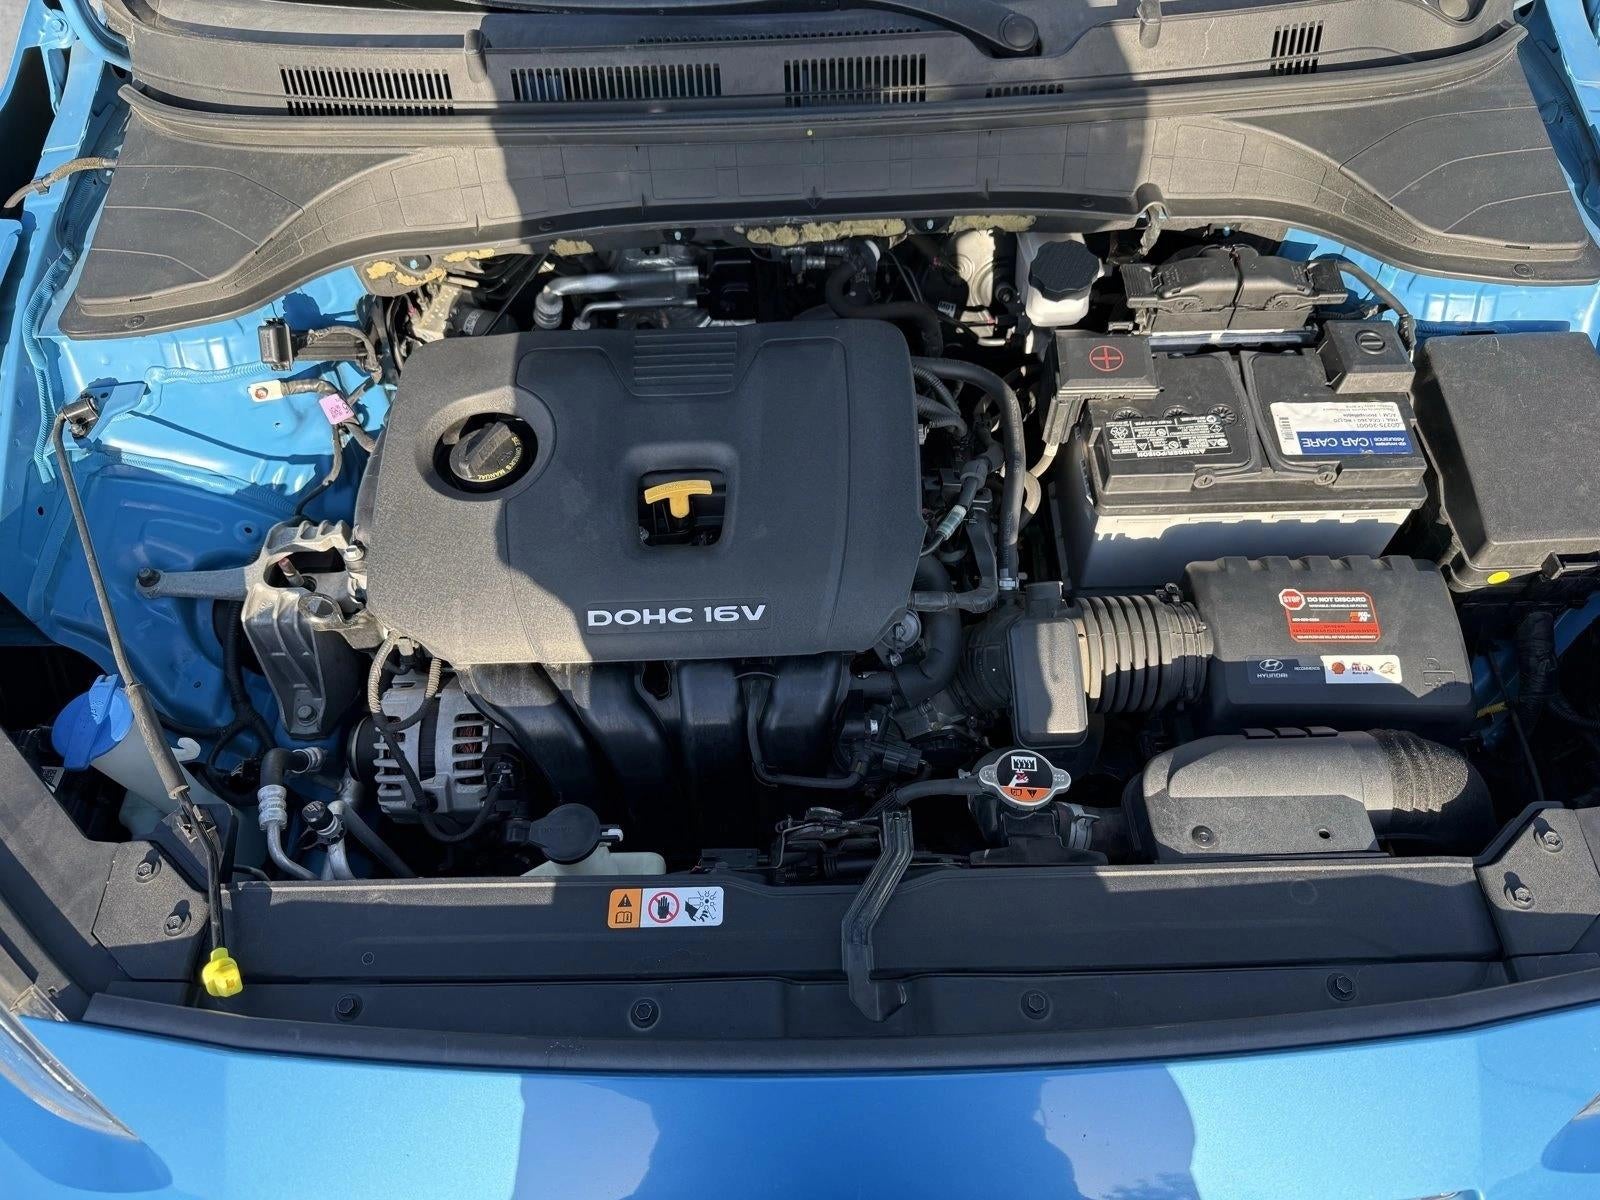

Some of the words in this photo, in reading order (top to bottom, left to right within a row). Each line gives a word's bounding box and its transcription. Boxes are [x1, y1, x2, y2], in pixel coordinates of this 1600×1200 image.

[1301, 437, 1338, 447] CARE
[1341, 437, 1369, 447] CAR
[477, 469, 506, 480] MANUAL
[587, 607, 693, 627] DOHC
[704, 604, 766, 623] 16V
